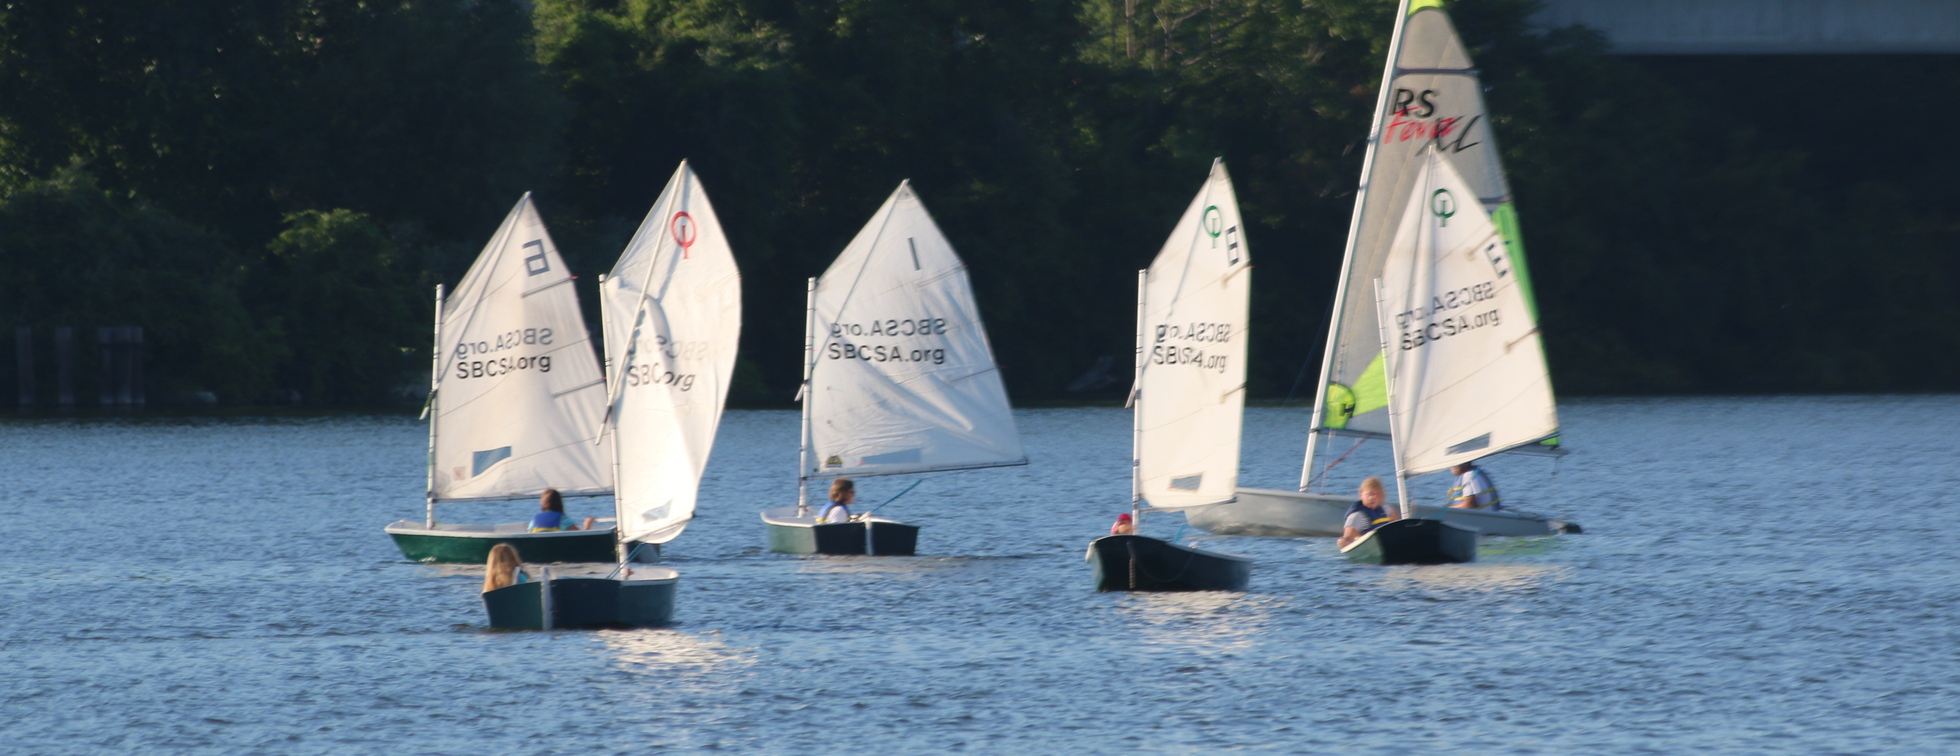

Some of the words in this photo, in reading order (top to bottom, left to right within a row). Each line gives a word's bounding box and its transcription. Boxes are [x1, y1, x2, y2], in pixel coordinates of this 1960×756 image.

[1390, 88, 1438, 118] RS
[1415, 113, 1486, 157] XL
[828, 342, 944, 365] SBCSA.org
